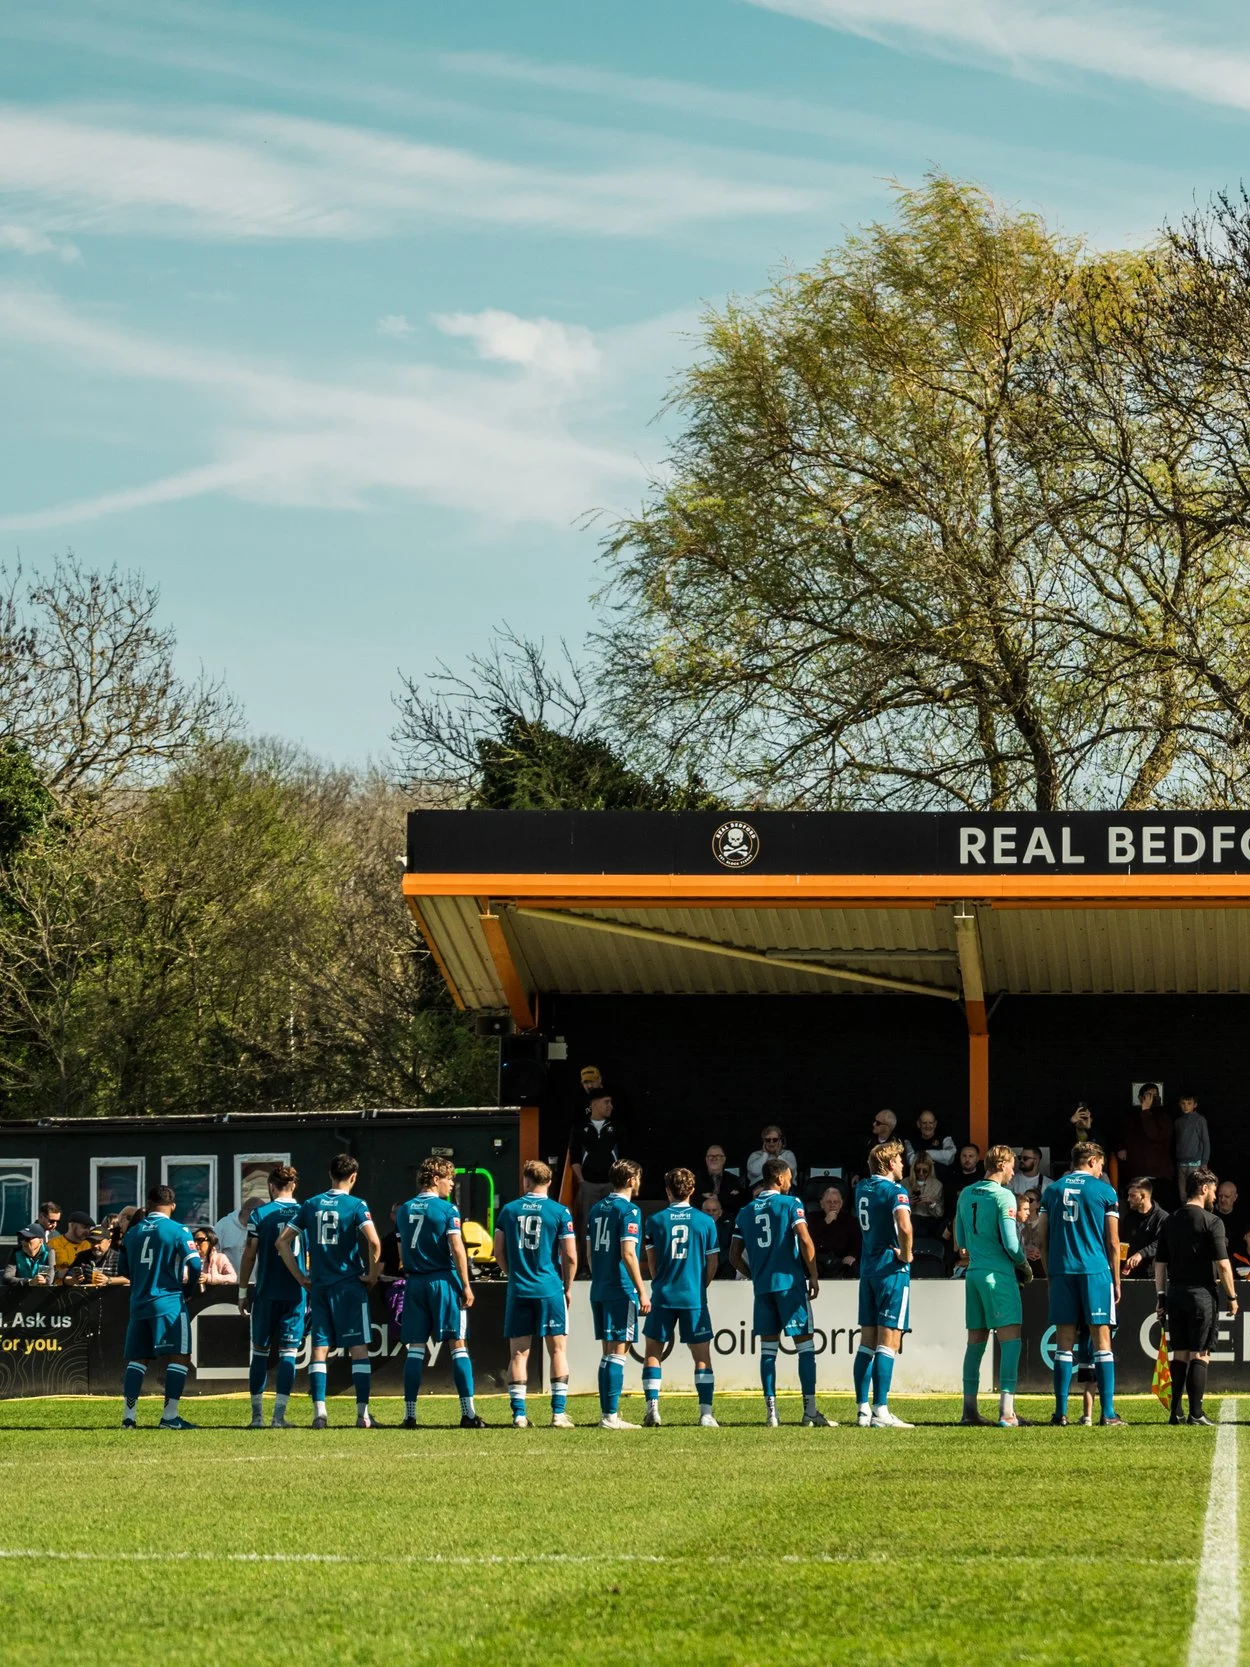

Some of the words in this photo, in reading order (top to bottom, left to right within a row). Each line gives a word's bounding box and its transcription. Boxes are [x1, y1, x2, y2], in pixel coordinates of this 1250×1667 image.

[716, 825, 729, 838] REAL
[730, 823, 756, 838] BEDFORD
[959, 826, 1085, 865] REAL
[858, 1197, 870, 1232] 6
[971, 1202, 978, 1235] 1
[1062, 1188, 1081, 1222] 5
[314, 1209, 339, 1246] 12
[408, 1214, 425, 1250] 7
[516, 1214, 543, 1251] 19
[594, 1216, 611, 1253] 14
[671, 1224, 689, 1260] 2
[754, 1213, 772, 1249] 3
[140, 1235, 154, 1271] 4
[12, 1312, 46, 1328] Ask
[51, 1315, 72, 1328] us
[24, 1338, 63, 1355] you.
